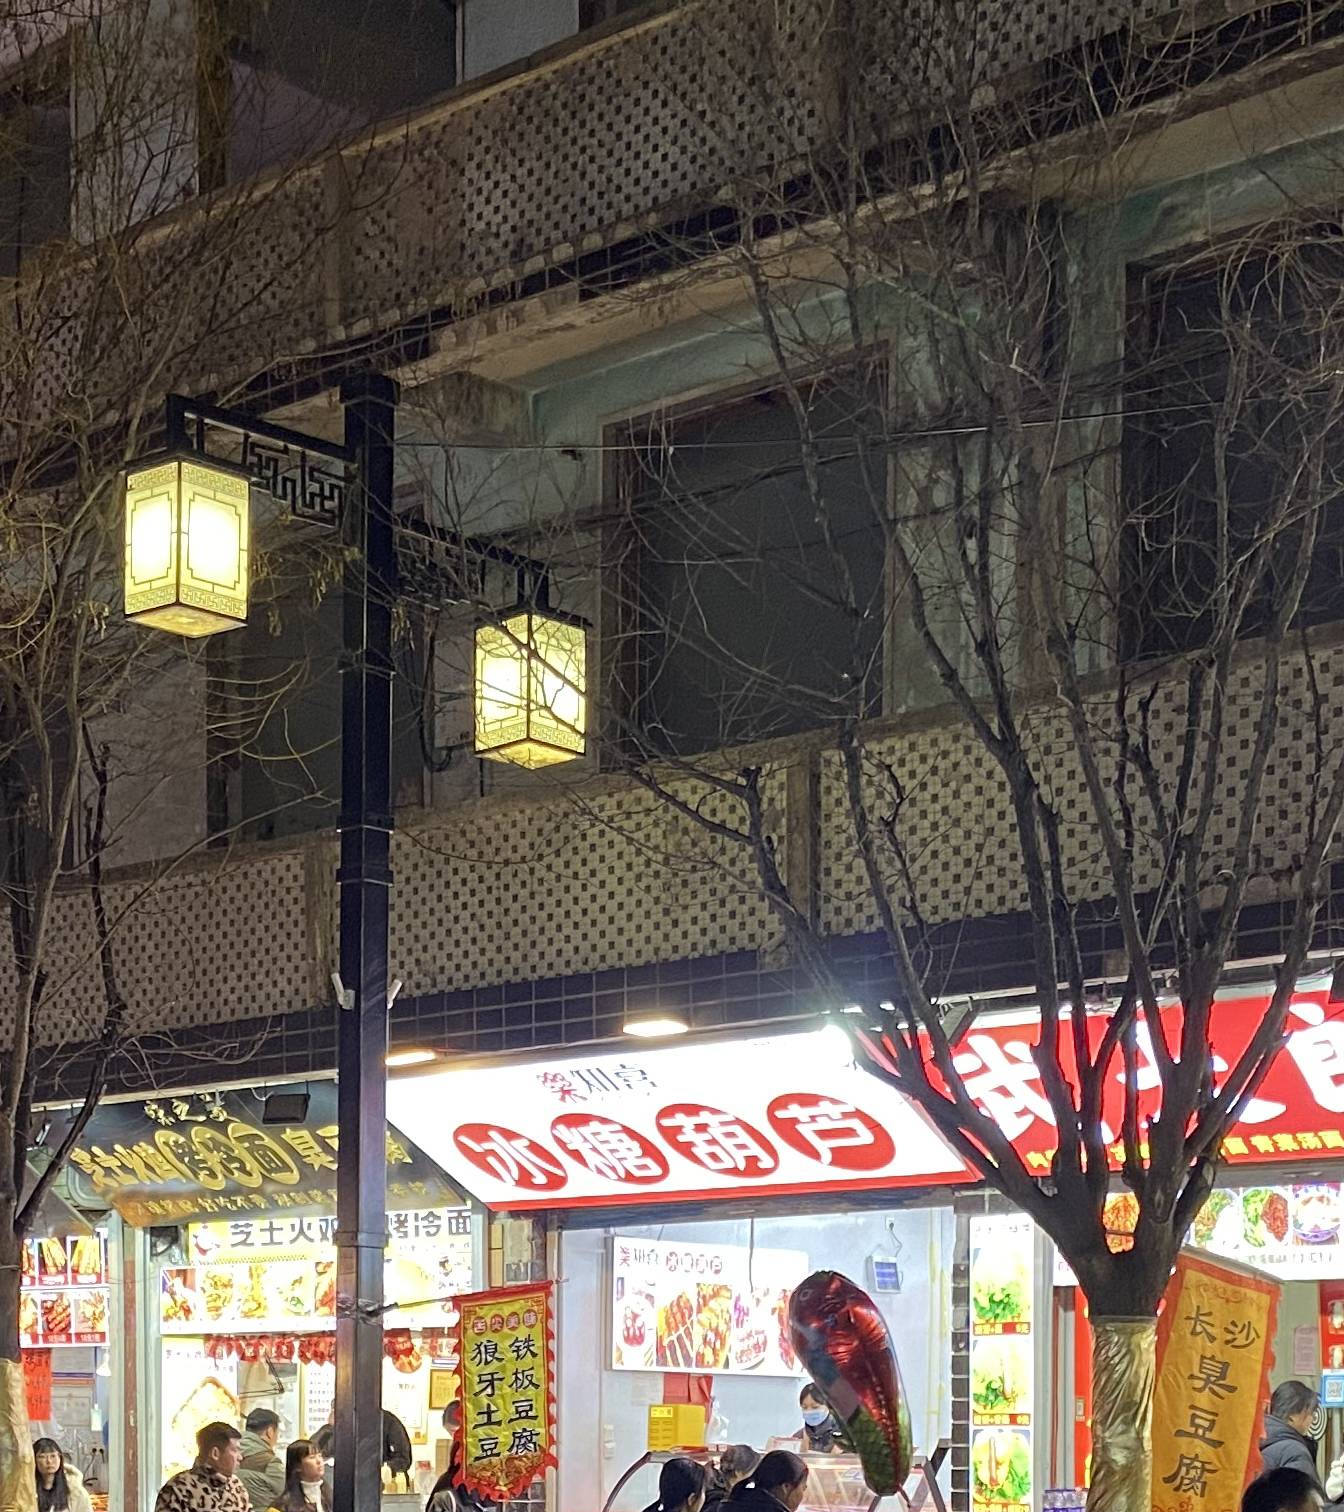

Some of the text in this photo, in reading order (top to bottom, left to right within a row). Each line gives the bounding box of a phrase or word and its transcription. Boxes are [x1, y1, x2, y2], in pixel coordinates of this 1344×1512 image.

[457, 1097, 877, 1188] 冰糖葫芦
[1183, 1304, 1262, 1351] 长沙
[470, 1339, 506, 1463] 狼牙土豆
[506, 1333, 541, 1457] 铁板豆腐
[1162, 1353, 1239, 1499] 臭豆腐
